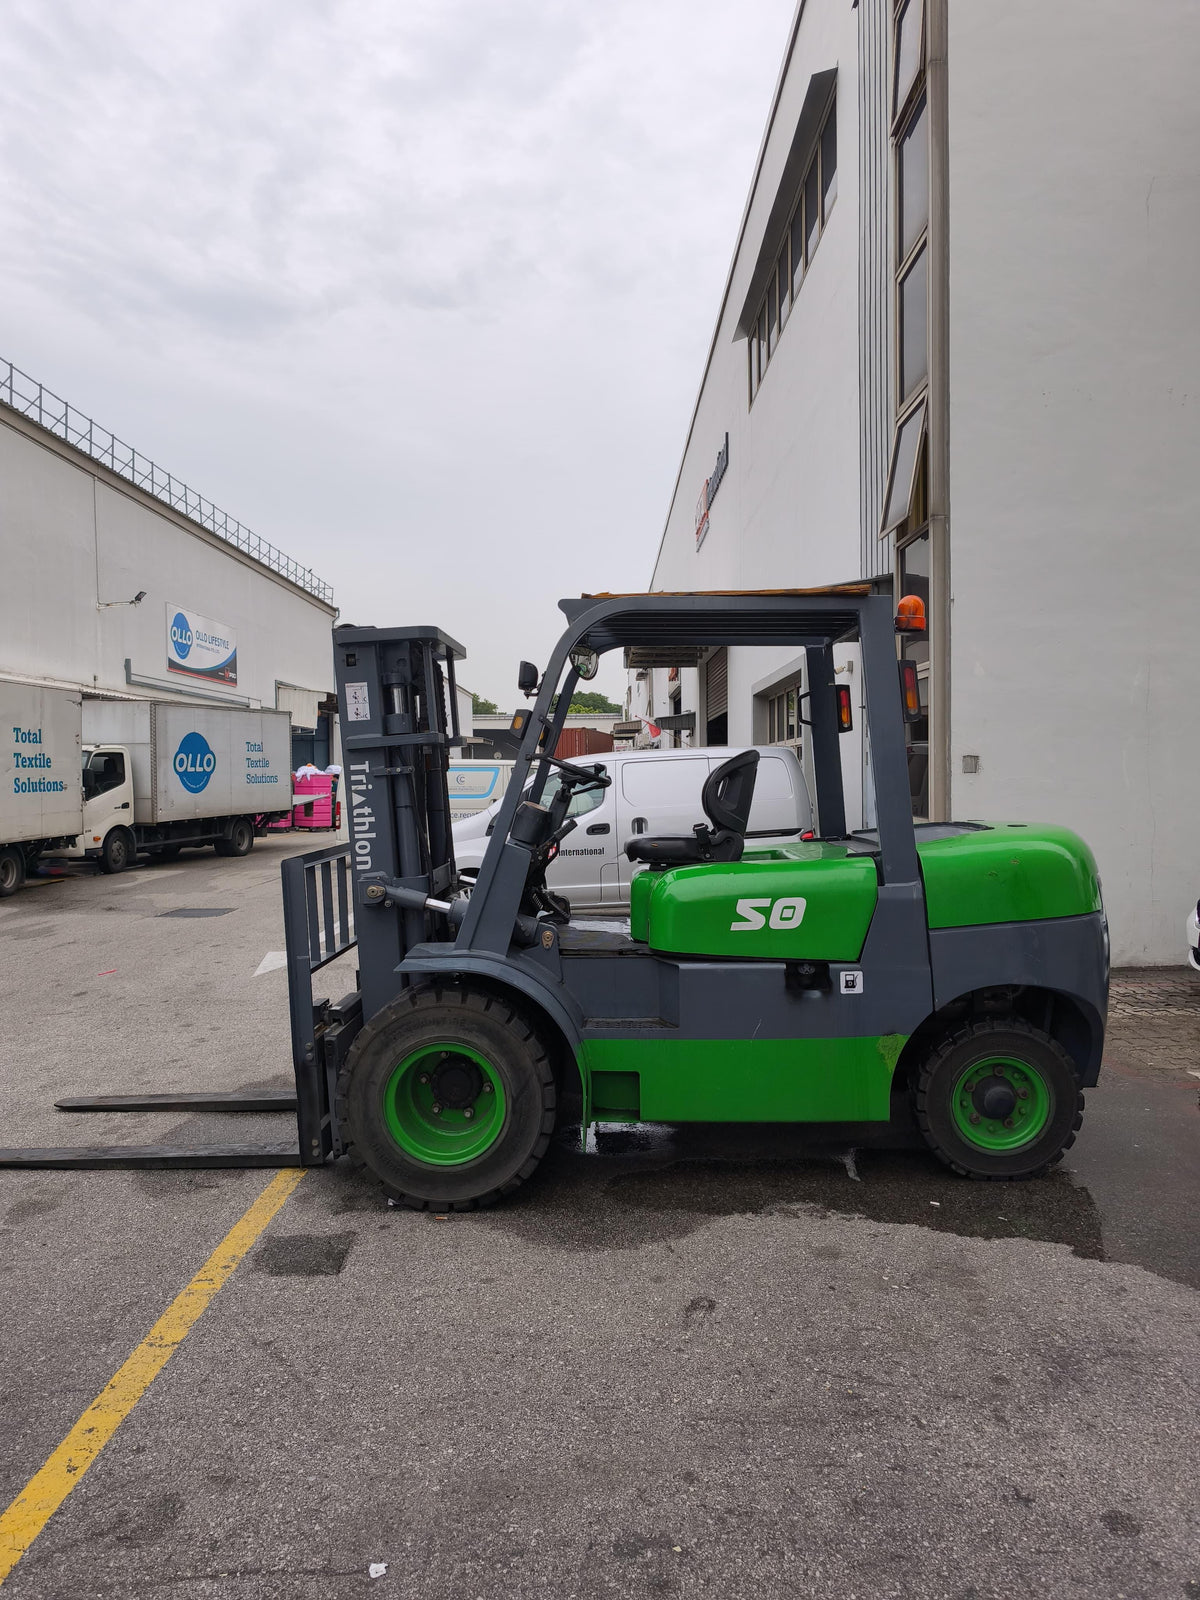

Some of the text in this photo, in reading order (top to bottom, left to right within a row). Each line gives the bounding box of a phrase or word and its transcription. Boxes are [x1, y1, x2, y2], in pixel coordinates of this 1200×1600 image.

[171, 626, 192, 646] OLLO
[208, 633, 230, 650] LIFESTYLE
[13, 727, 43, 744] Total
[245, 741, 264, 753] Total
[13, 752, 52, 769] Textile
[175, 753, 215, 773] OLLO
[245, 757, 270, 769] Textile
[13, 777, 65, 794] Solutions
[245, 773, 279, 785] Solutions
